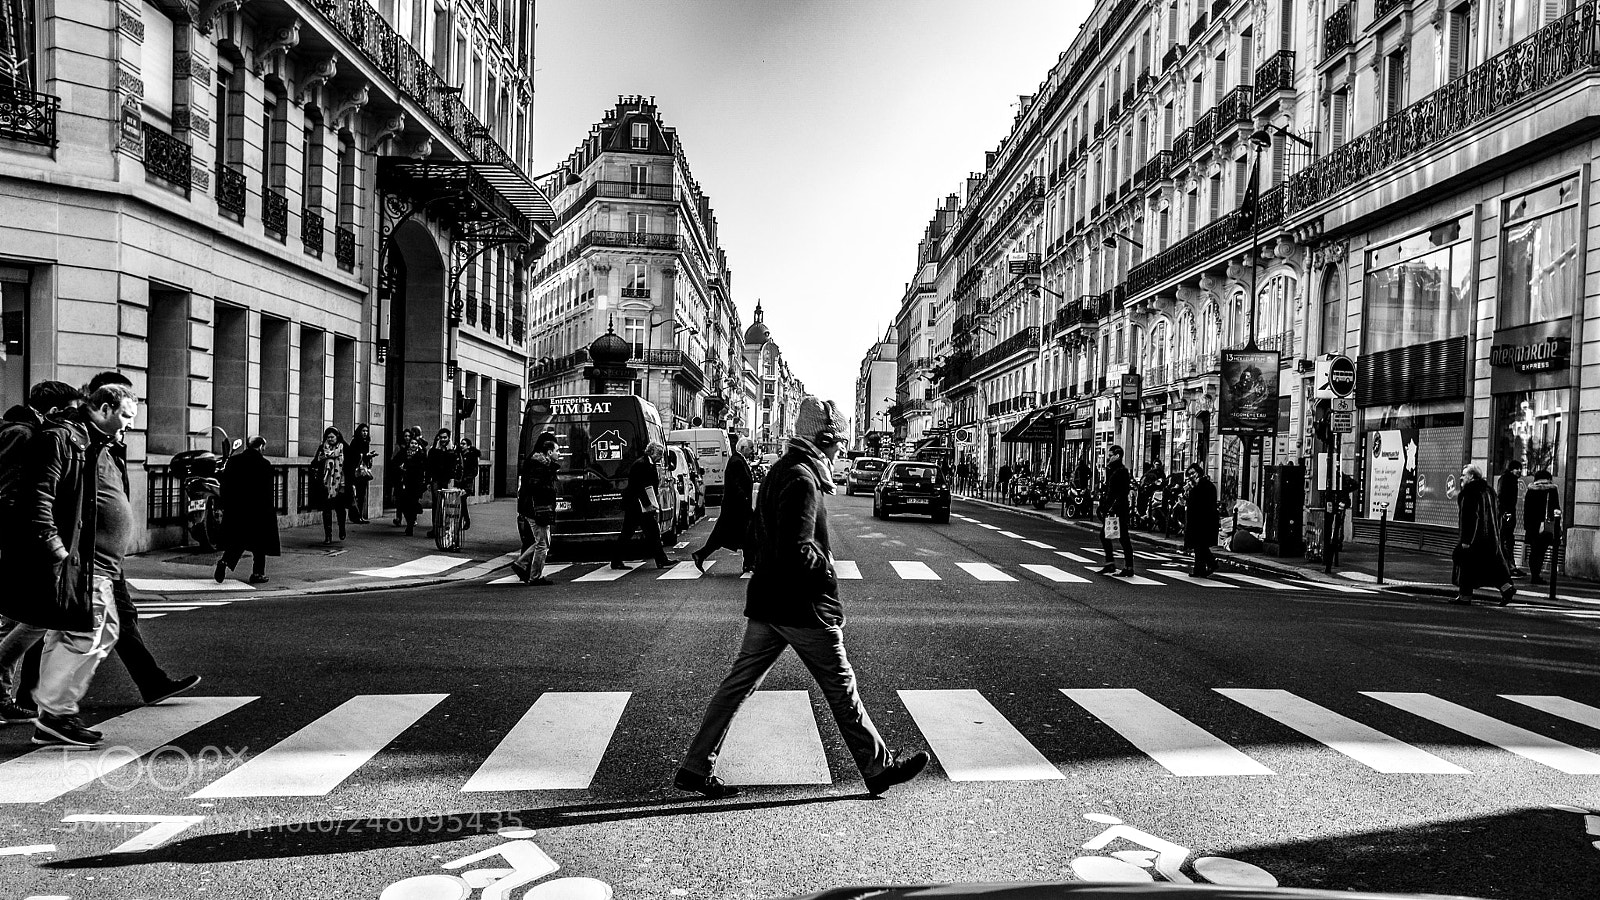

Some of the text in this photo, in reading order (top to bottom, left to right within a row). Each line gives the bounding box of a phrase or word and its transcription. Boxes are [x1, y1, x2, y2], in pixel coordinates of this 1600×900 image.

[1521, 361, 1550, 371] EXPRESS
[550, 397, 590, 405] Entreprise
[550, 402, 612, 415] TIM BAT
